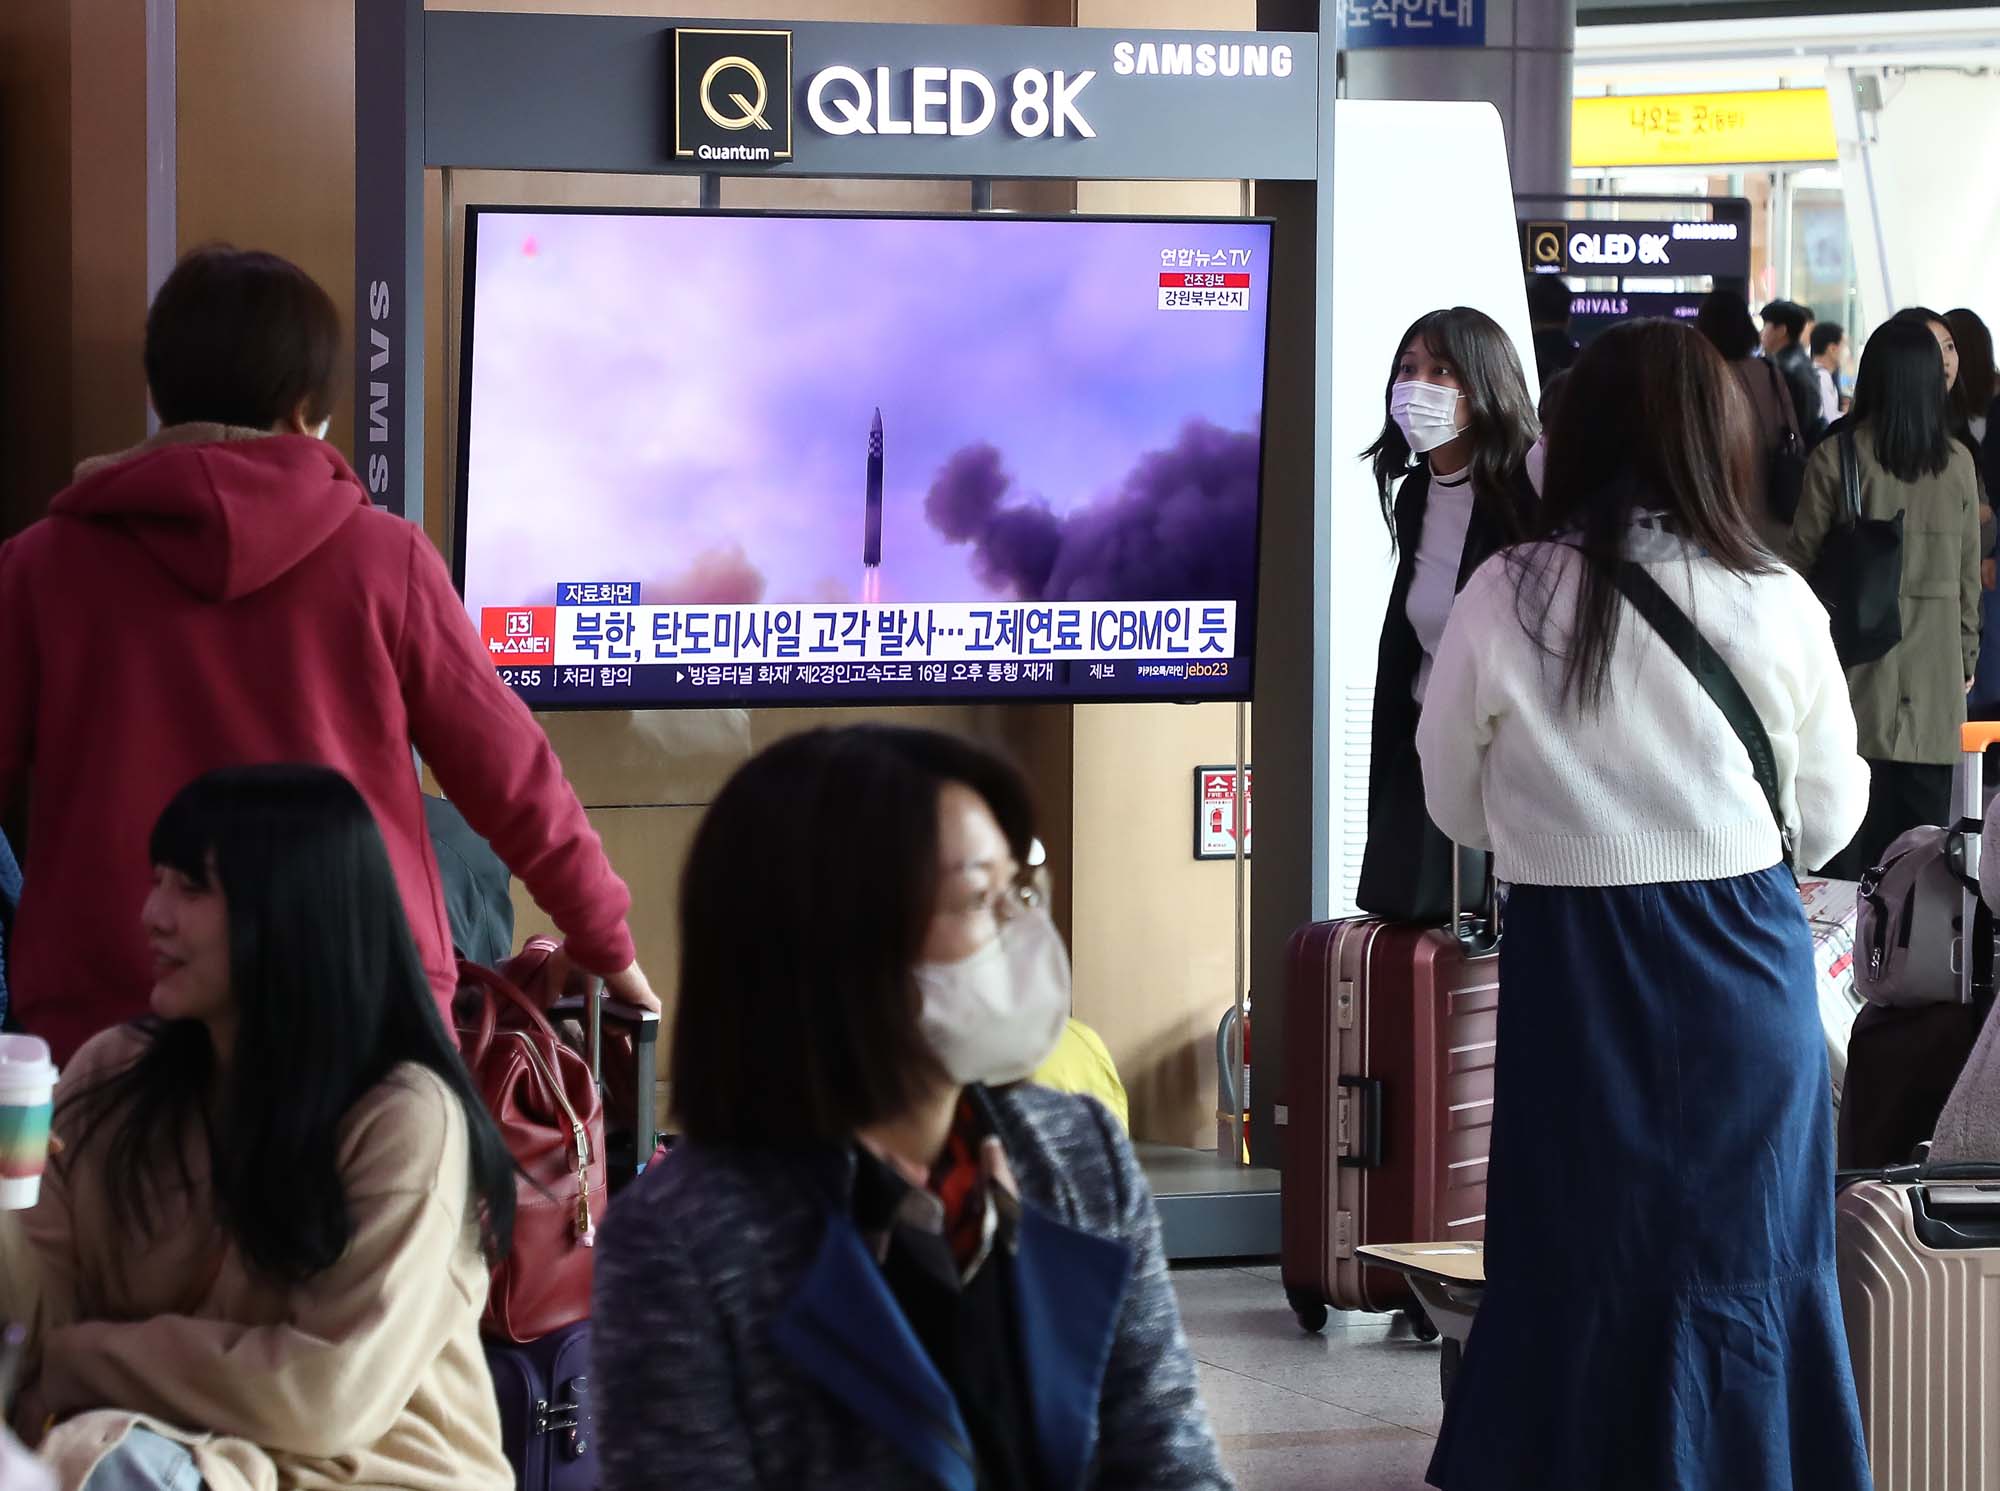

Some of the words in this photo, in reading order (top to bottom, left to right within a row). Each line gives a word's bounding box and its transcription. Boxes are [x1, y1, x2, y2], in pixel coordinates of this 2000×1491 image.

[1113, 41, 1293, 78] SAMSUNG
[700, 56, 773, 131] Q
[807, 65, 997, 136] QLED
[1010, 67, 1097, 138] 8K
[698, 145, 769, 160] Quantum
[1535, 231, 1560, 262] Q
[1569, 233, 1637, 264] QLED
[1638, 233, 1671, 264] 8K
[1183, 273, 1225, 287] 건조경보
[1165, 290, 1243, 307] 강원북부산지
[369, 280, 390, 512] SAMS
[564, 584, 633, 605] 자료화면
[508, 615, 530, 634] 13
[572, 611, 641, 663] 북한,
[652, 610, 801, 658] 탄도미사일
[808, 609, 871, 657] 고각
[1090, 607, 1190, 653] ICBM인
[1198, 607, 1228, 654] 듯
[488, 637, 550, 654] 뉴스센터
[563, 667, 595, 687] 처리
[600, 667, 632, 687] 합의
[796, 664, 913, 685] 제2경인고속도로
[918, 663, 948, 682] 16일
[951, 662, 983, 682] 오후
[986, 662, 1019, 683] 통행
[1022, 661, 1054, 682] 재개
[1089, 663, 1116, 679] 제보
[1183, 662, 1229, 680] jebo23
